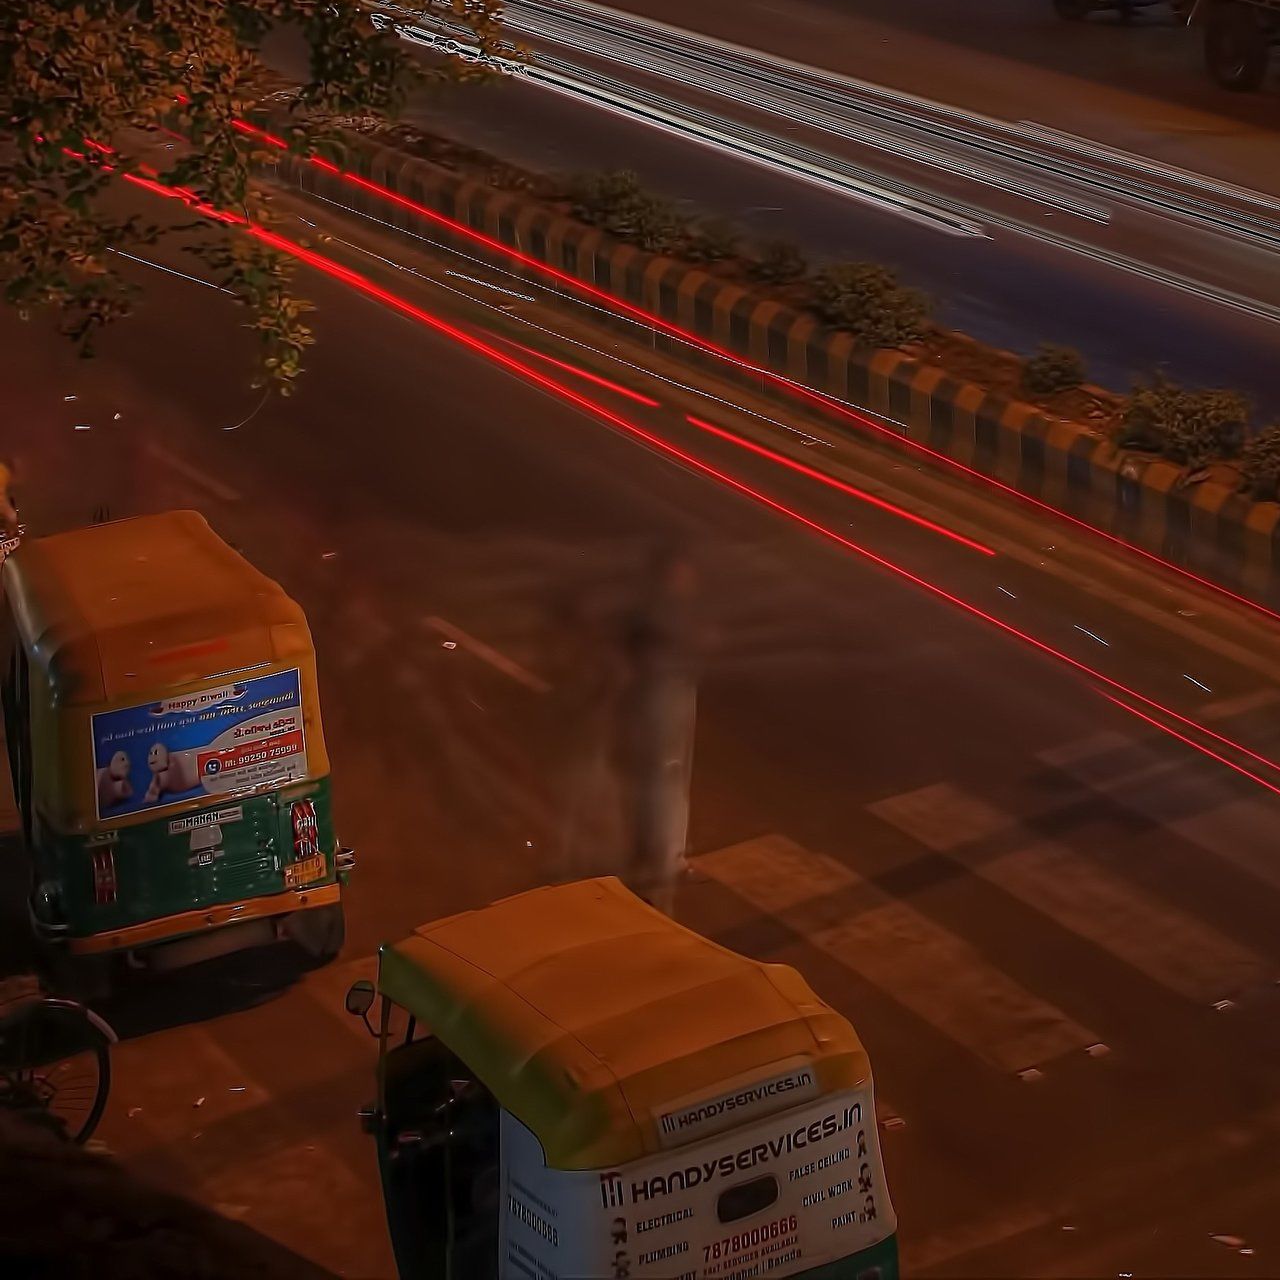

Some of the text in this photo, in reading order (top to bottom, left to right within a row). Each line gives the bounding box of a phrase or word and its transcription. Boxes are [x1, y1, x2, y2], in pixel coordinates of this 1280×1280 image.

[168, 690, 229, 710] Happy Diwali
[678, 1072, 811, 1130] HANDYSERVICES.IN
[631, 1102, 863, 1204] HANDYSERVICES.IN
[788, 1162, 815, 1182] FALSE
[828, 1179, 853, 1198] WORK
[636, 1207, 695, 1234] ELECTRICAL
[832, 1210, 856, 1229] PAINT
[702, 1215, 798, 1263] 7878000666
